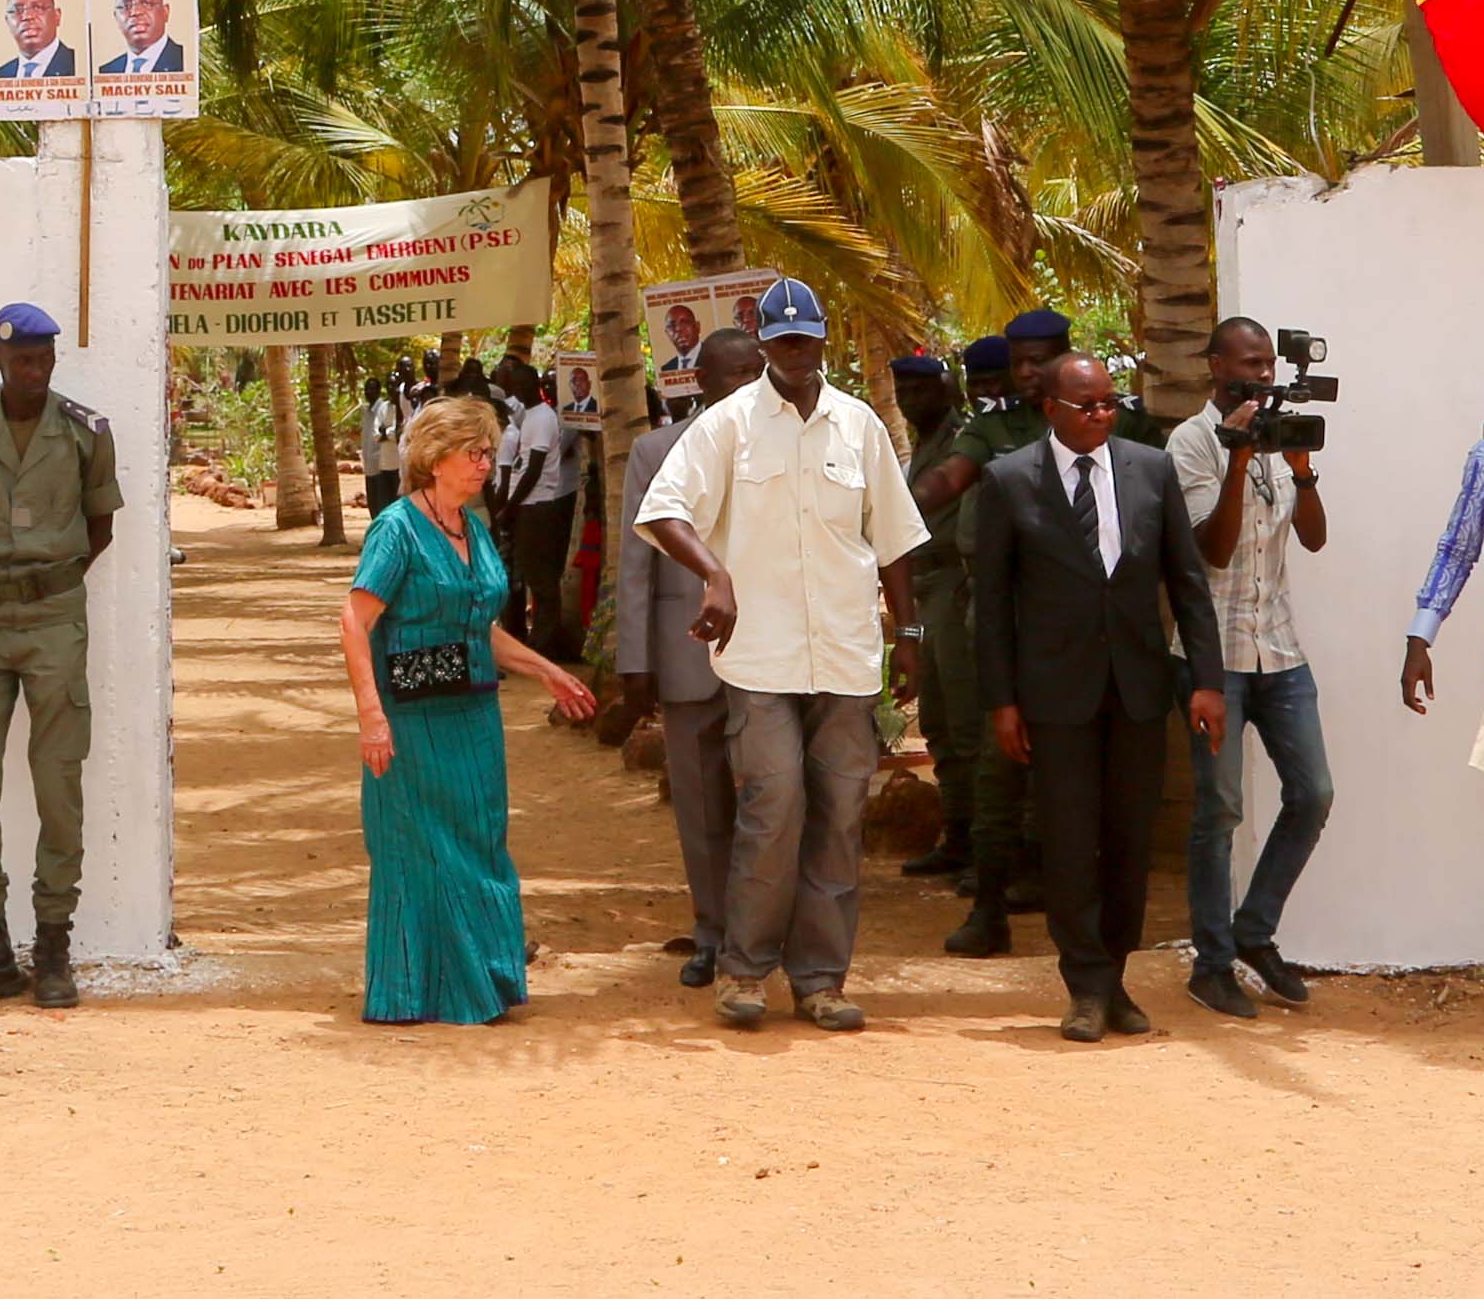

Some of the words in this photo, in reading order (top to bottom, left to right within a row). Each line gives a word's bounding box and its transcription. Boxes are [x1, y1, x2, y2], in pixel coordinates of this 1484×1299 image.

[47, 88, 79, 100] SALL
[101, 85, 151, 97] MACKY
[155, 84, 187, 95] SALL
[222, 220, 344, 243] KAYDARA
[188, 258, 205, 270] DU
[213, 253, 263, 272] PLAN
[274, 247, 354, 268] SENEGAL
[366, 235, 457, 261] EMERGENT
[169, 282, 256, 301] TENARIAT
[269, 279, 314, 299] AVEC
[325, 275, 358, 296] LES
[369, 265, 471, 292] COMMUNES
[225, 310, 309, 334] DIOFIOR
[321, 311, 338, 328] ET
[352, 298, 457, 328] TASSETTE
